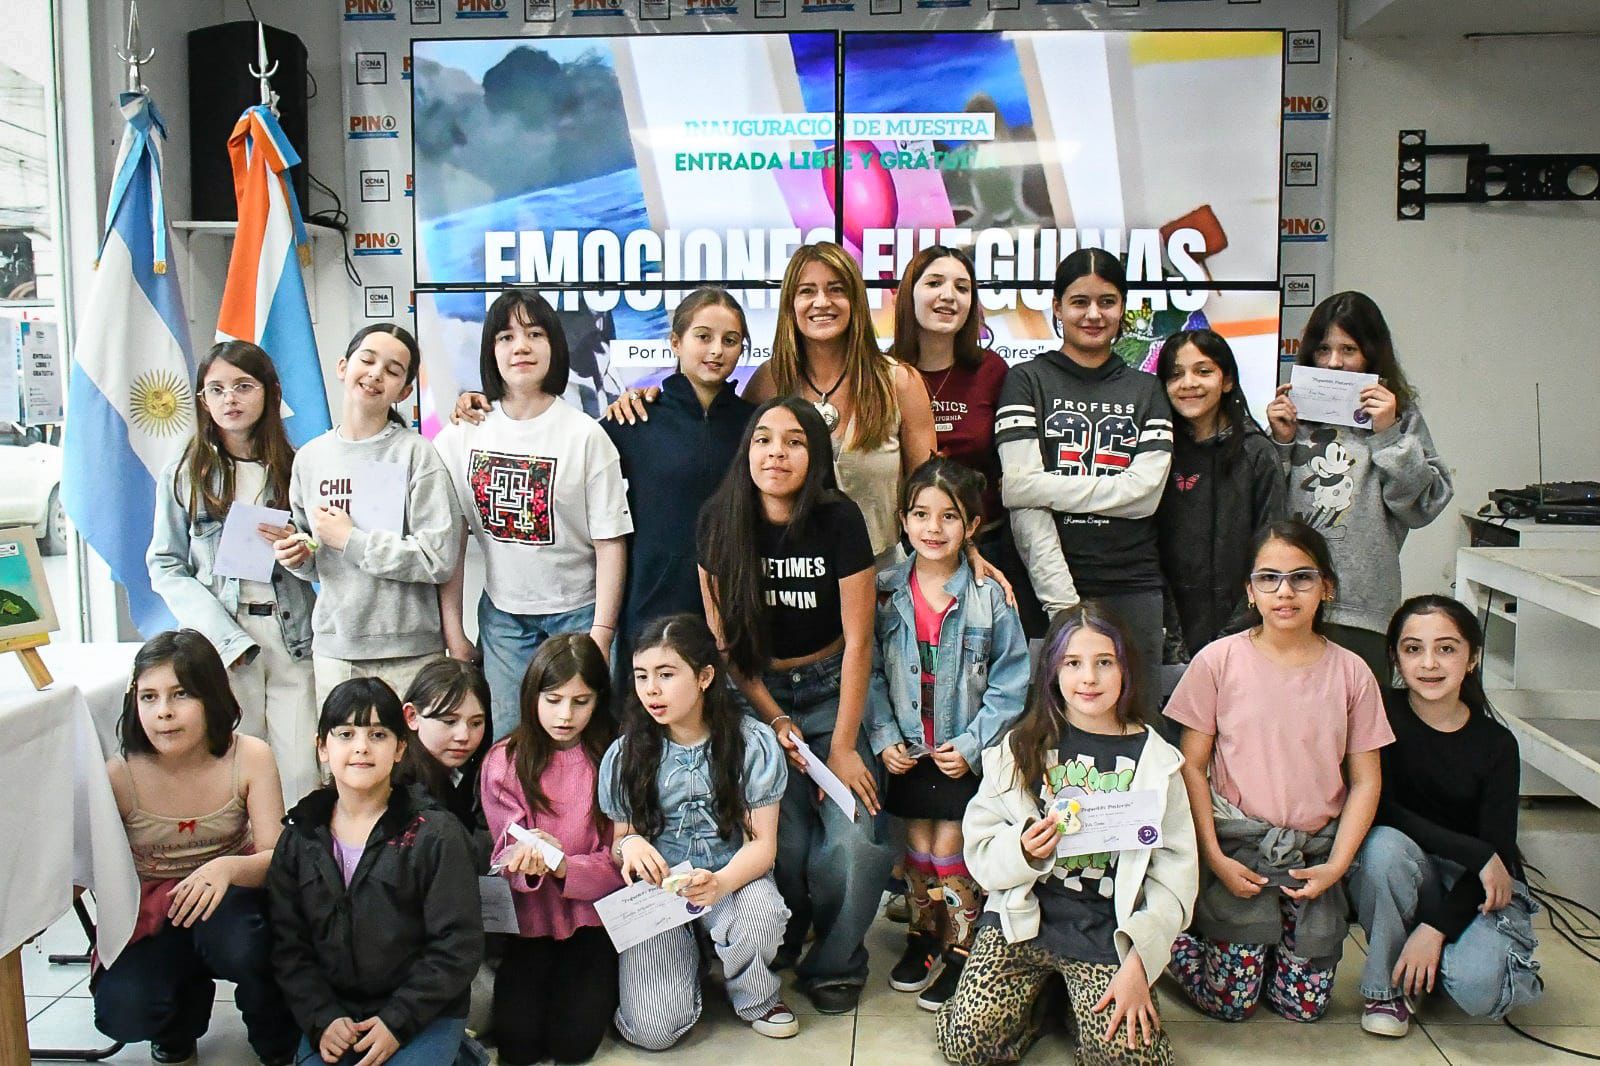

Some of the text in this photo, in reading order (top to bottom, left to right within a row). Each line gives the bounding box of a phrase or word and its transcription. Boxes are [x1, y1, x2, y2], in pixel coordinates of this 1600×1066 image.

[684, 117, 989, 137] INAUGURACIÓ DE MUESTRA
[675, 152, 783, 171] ENTRADA
[859, 151, 873, 170] Y
[485, 229, 836, 312] EMOCIONE
[629, 346, 656, 359] Por
[1053, 398, 1136, 415] PROFESS
[779, 591, 817, 609] WIN
